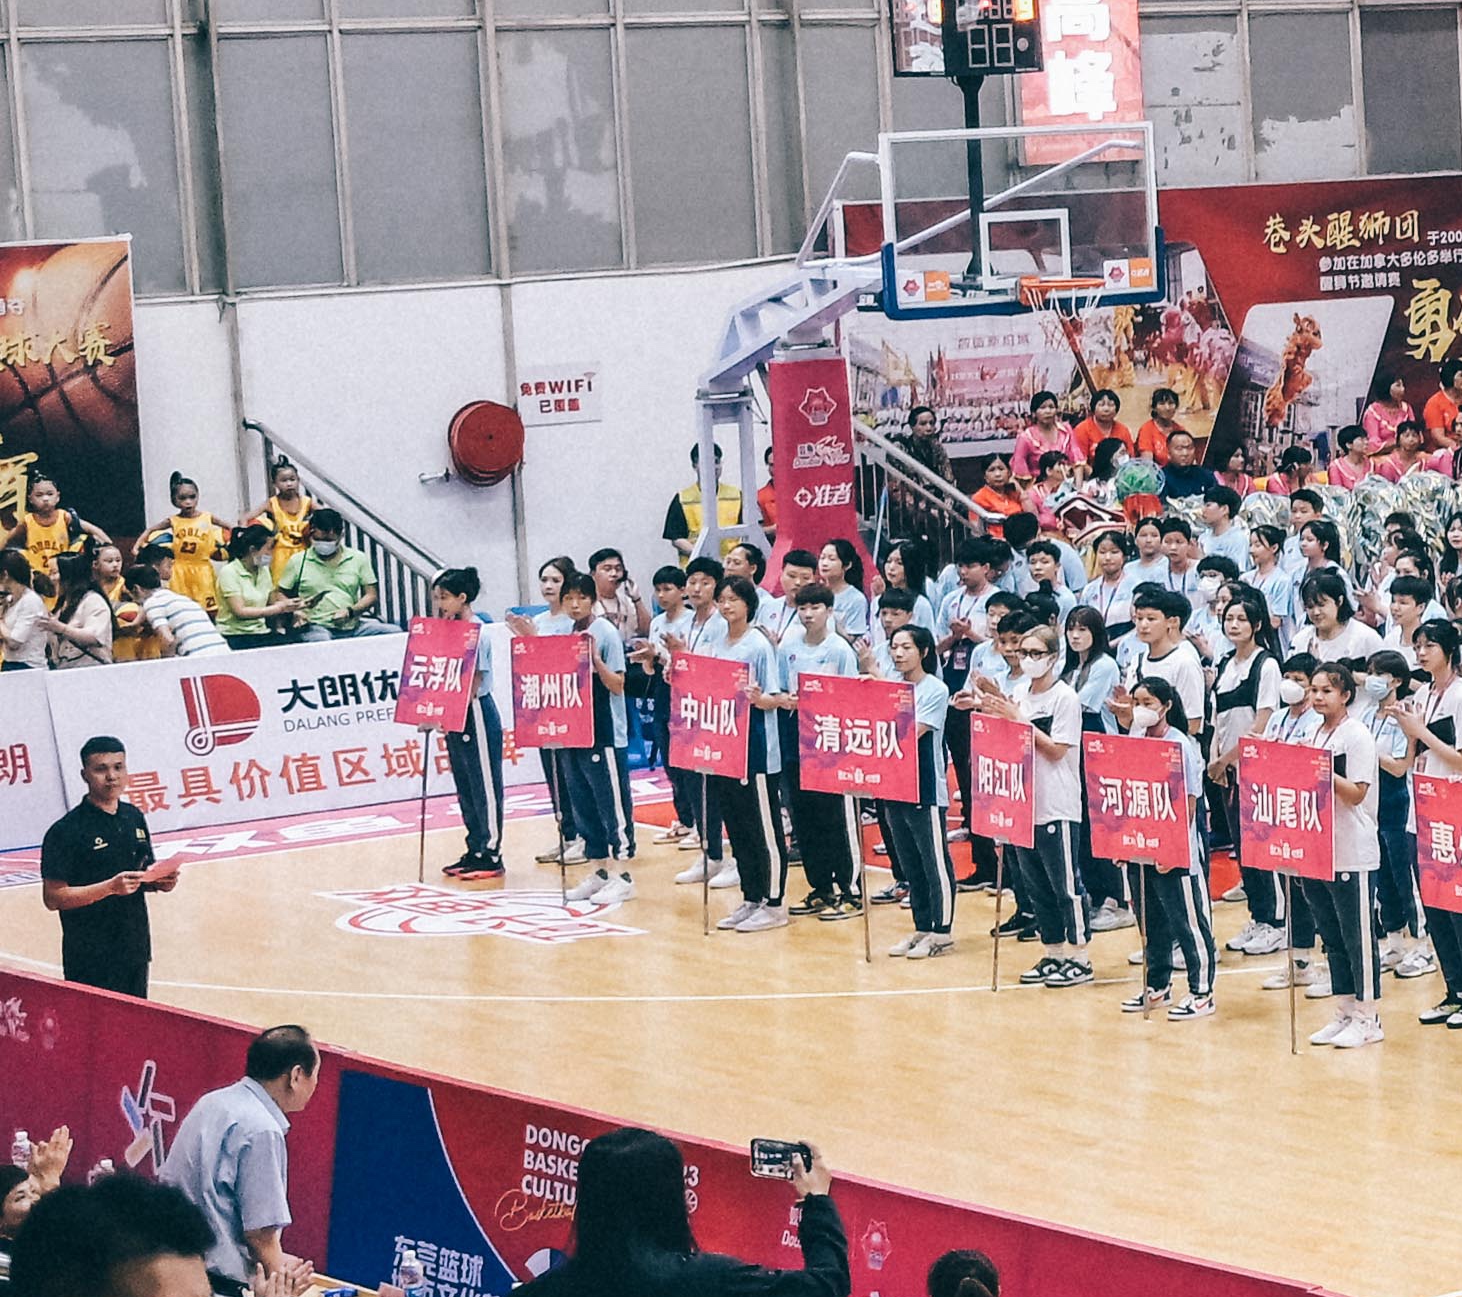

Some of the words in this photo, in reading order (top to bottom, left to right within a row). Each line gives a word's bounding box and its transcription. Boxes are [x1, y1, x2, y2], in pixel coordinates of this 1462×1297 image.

[1262, 208, 1421, 255] 巷头醒狮团
[1319, 270, 1402, 293] 醒狮节邀请赛
[180, 541, 198, 555] 23
[277, 669, 400, 716] 大朗优
[410, 652, 464, 696] 云浮队
[520, 673, 583, 711] 潮州队
[283, 712, 351, 734] DALANG
[679, 691, 738, 738] 中山队
[813, 713, 904, 761] 清远队
[977, 756, 1027, 804] 阳江队
[1098, 776, 1178, 824] 河源队
[1251, 782, 1324, 834] 汕尾队
[525, 1124, 588, 1156] DONG
[523, 1149, 578, 1182] BASKE
[521, 1174, 577, 1205] CULTU
